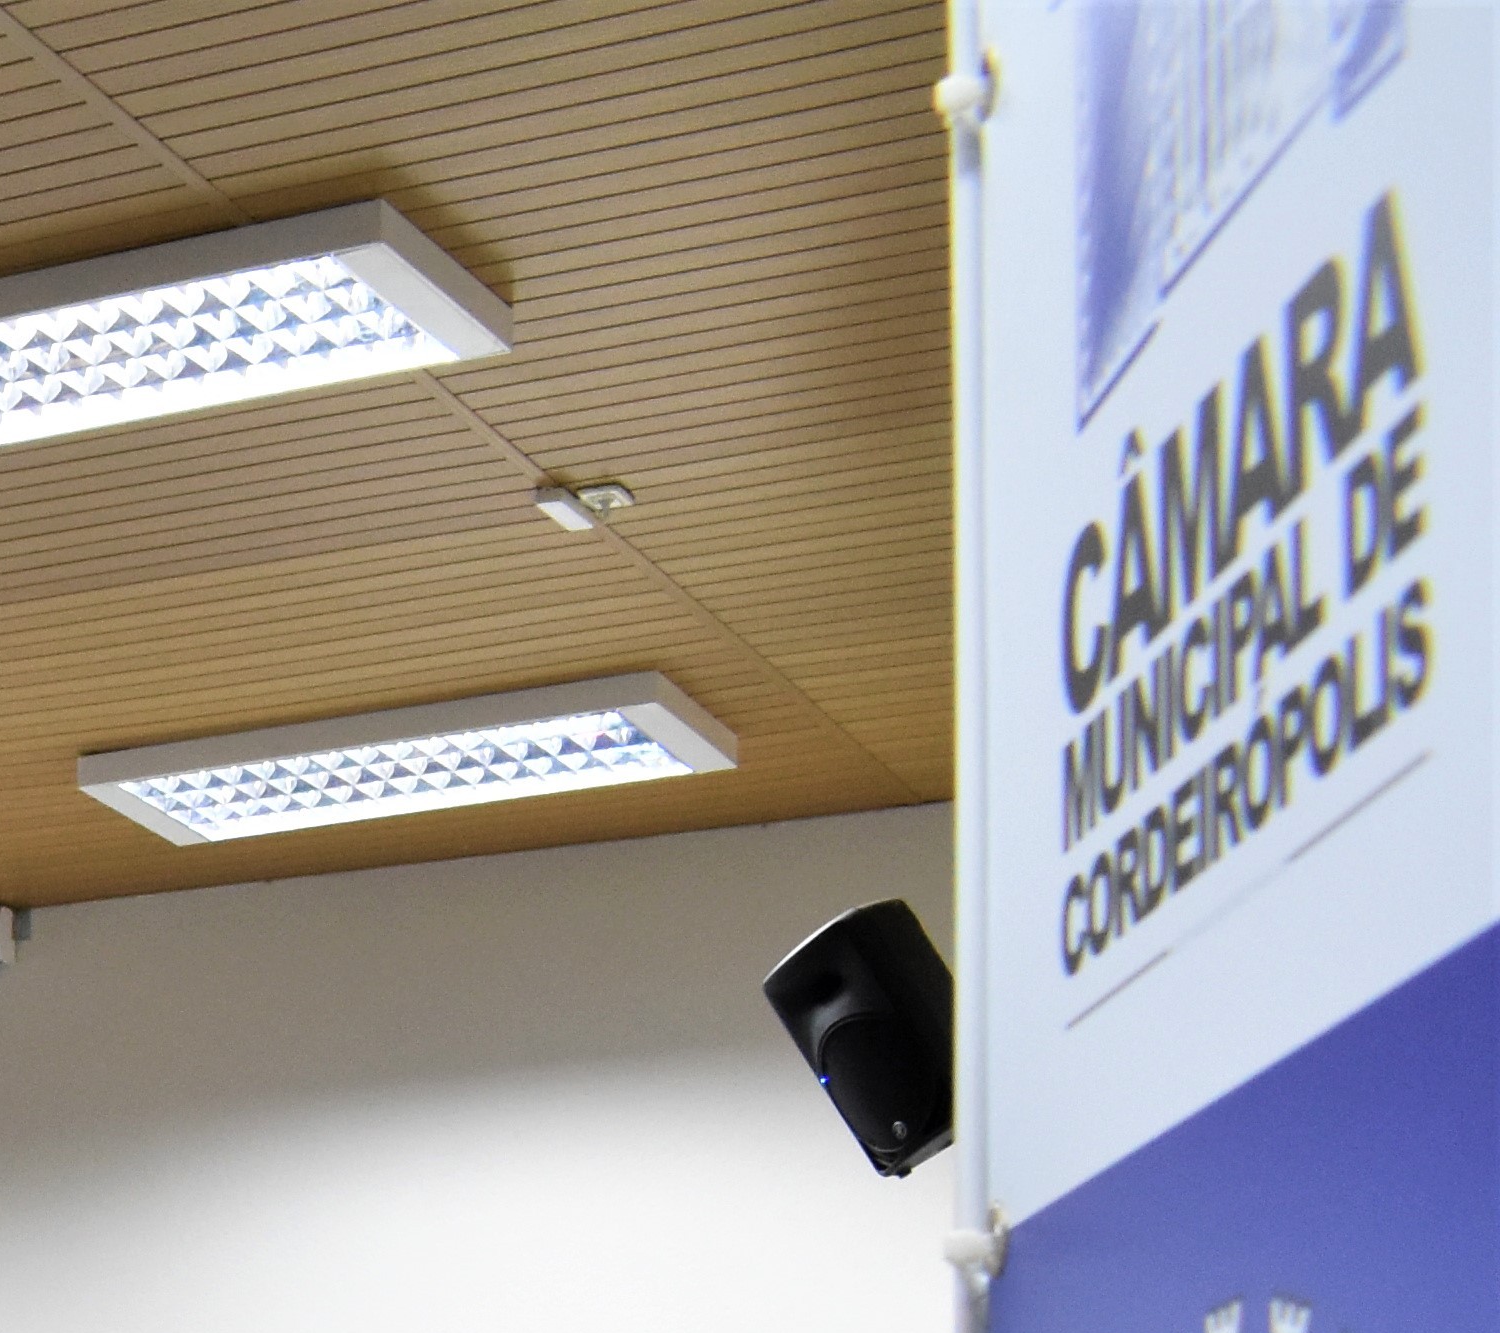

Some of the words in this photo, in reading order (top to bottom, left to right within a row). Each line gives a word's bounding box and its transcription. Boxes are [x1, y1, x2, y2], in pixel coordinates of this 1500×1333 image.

[1063, 187, 1422, 716] CÂMARA
[1063, 518, 1325, 852] MUNICIPAL
[1343, 402, 1425, 602] DE
[1063, 578, 1431, 976] CORDEIRÓPOLIS
